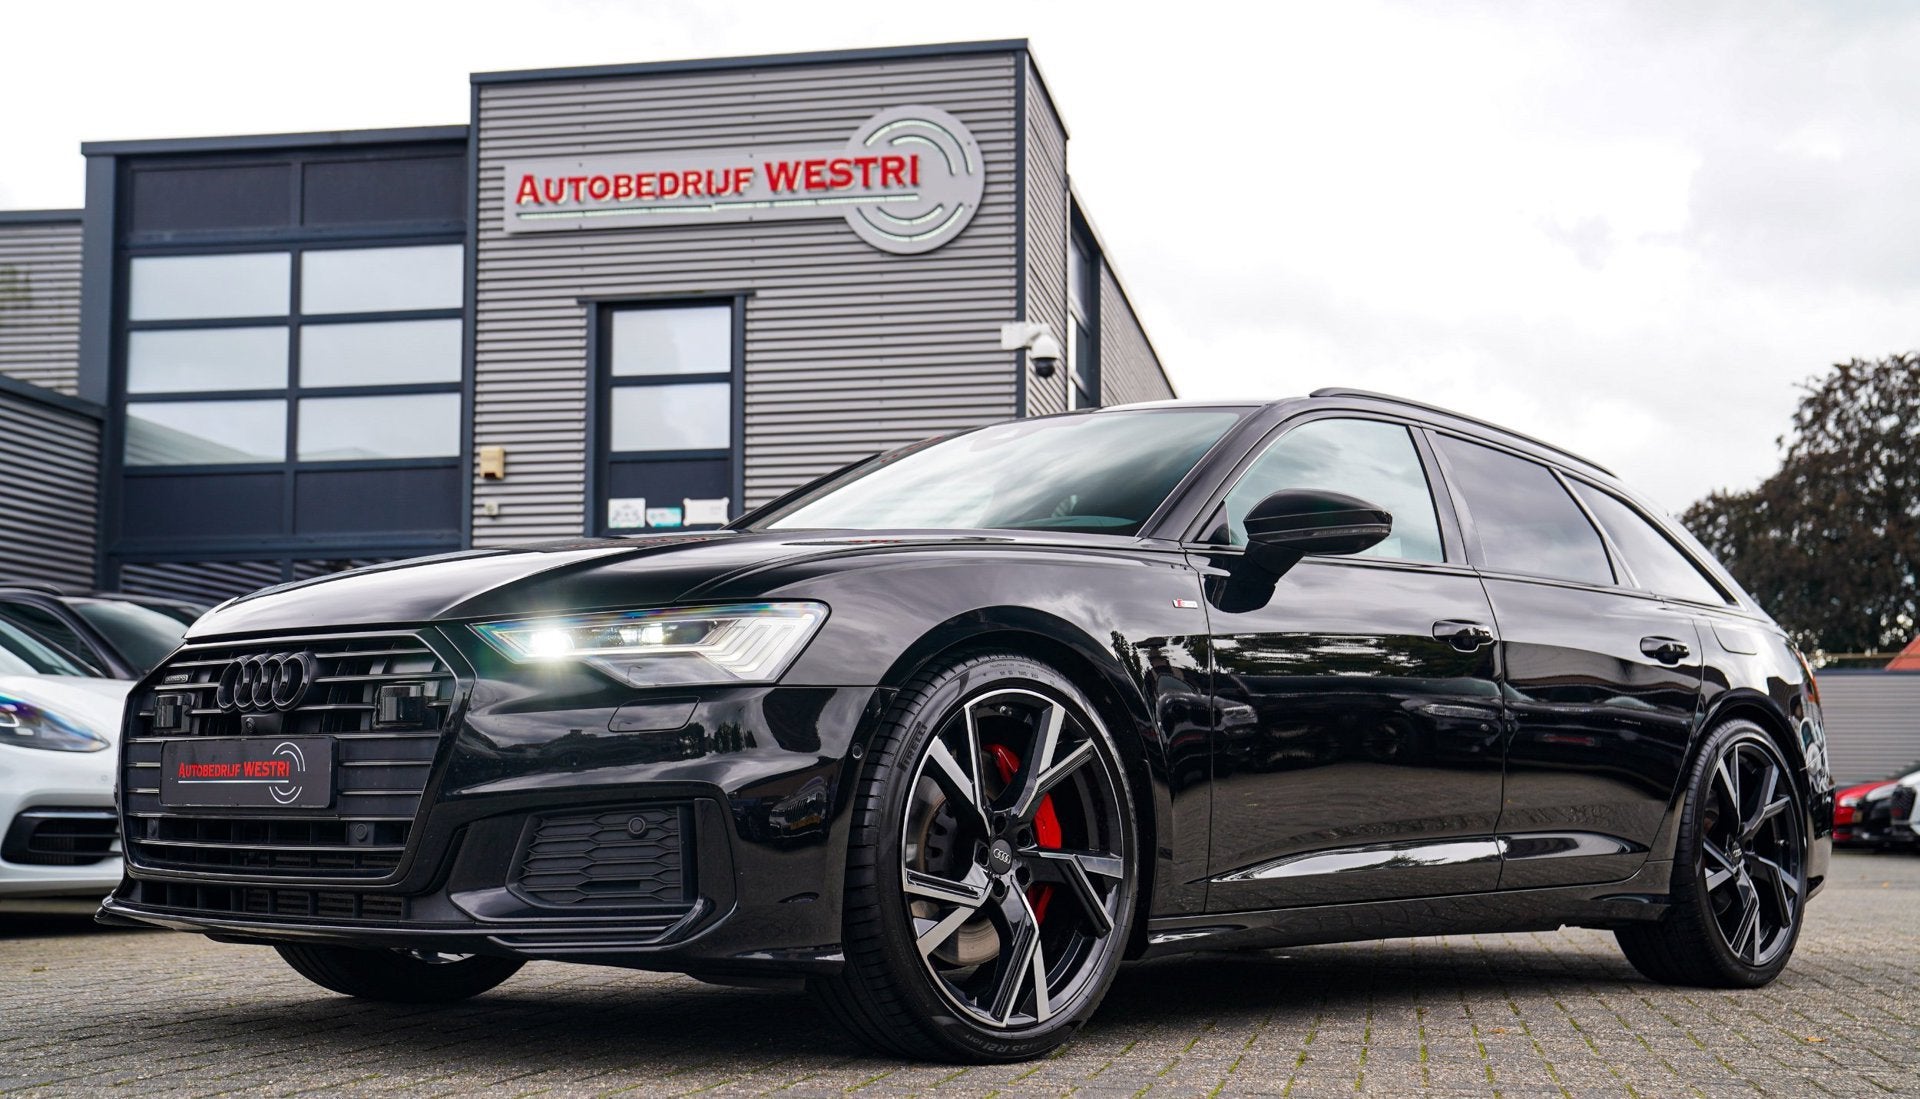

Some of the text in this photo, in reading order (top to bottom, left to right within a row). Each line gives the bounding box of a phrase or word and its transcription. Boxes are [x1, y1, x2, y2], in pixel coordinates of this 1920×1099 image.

[516, 154, 920, 206] AUTOBEDRIJF WESTRI
[178, 761, 290, 778] AUTOBEDRIJF WESTRI
[897, 721, 927, 771] PIRELLI
